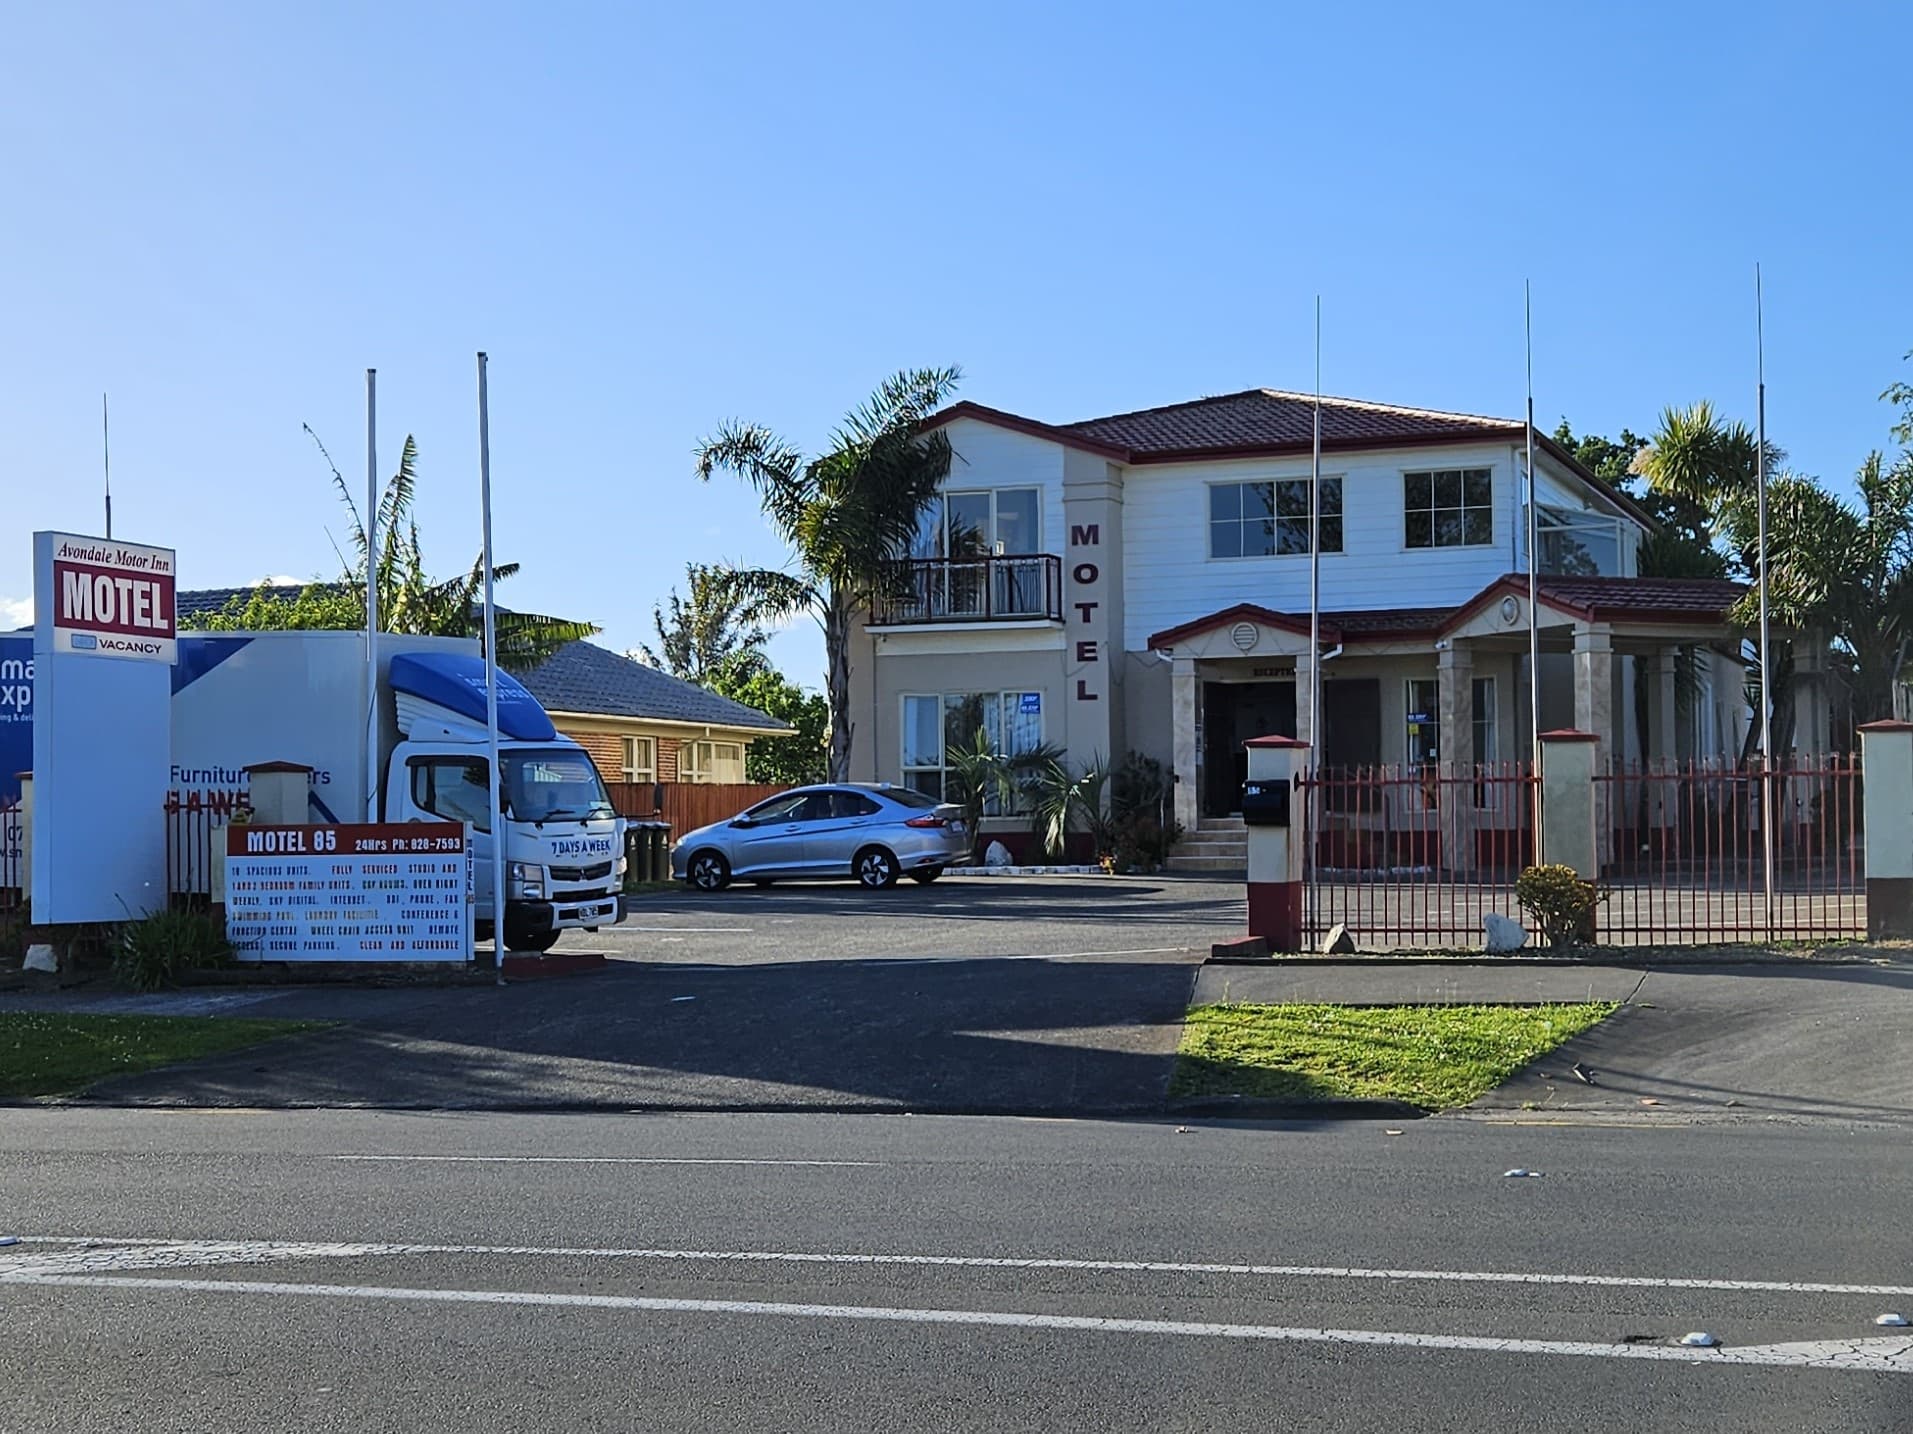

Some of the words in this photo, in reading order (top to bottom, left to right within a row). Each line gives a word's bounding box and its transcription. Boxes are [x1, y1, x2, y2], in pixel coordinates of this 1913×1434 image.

[58, 542, 112, 564] Avondale
[114, 549, 148, 568] Motor
[150, 554, 169, 572] Inn
[62, 570, 168, 630] MOTEL
[1072, 524, 1099, 701] MOTEL
[99, 639, 162, 654] VACANCY
[170, 765, 250, 784] Furnitur
[247, 830, 307, 852] MOTEL
[314, 830, 336, 851] 85
[355, 840, 386, 850] 24Hrs
[552, 842, 558, 854] 7
[560, 840, 580, 854] DAYS
[580, 840, 588, 853] A
[588, 840, 611, 852] WEEK
[332, 865, 352, 874] FULLY
[362, 864, 398, 874] SERVICED
[299, 880, 324, 890] FAMILY
